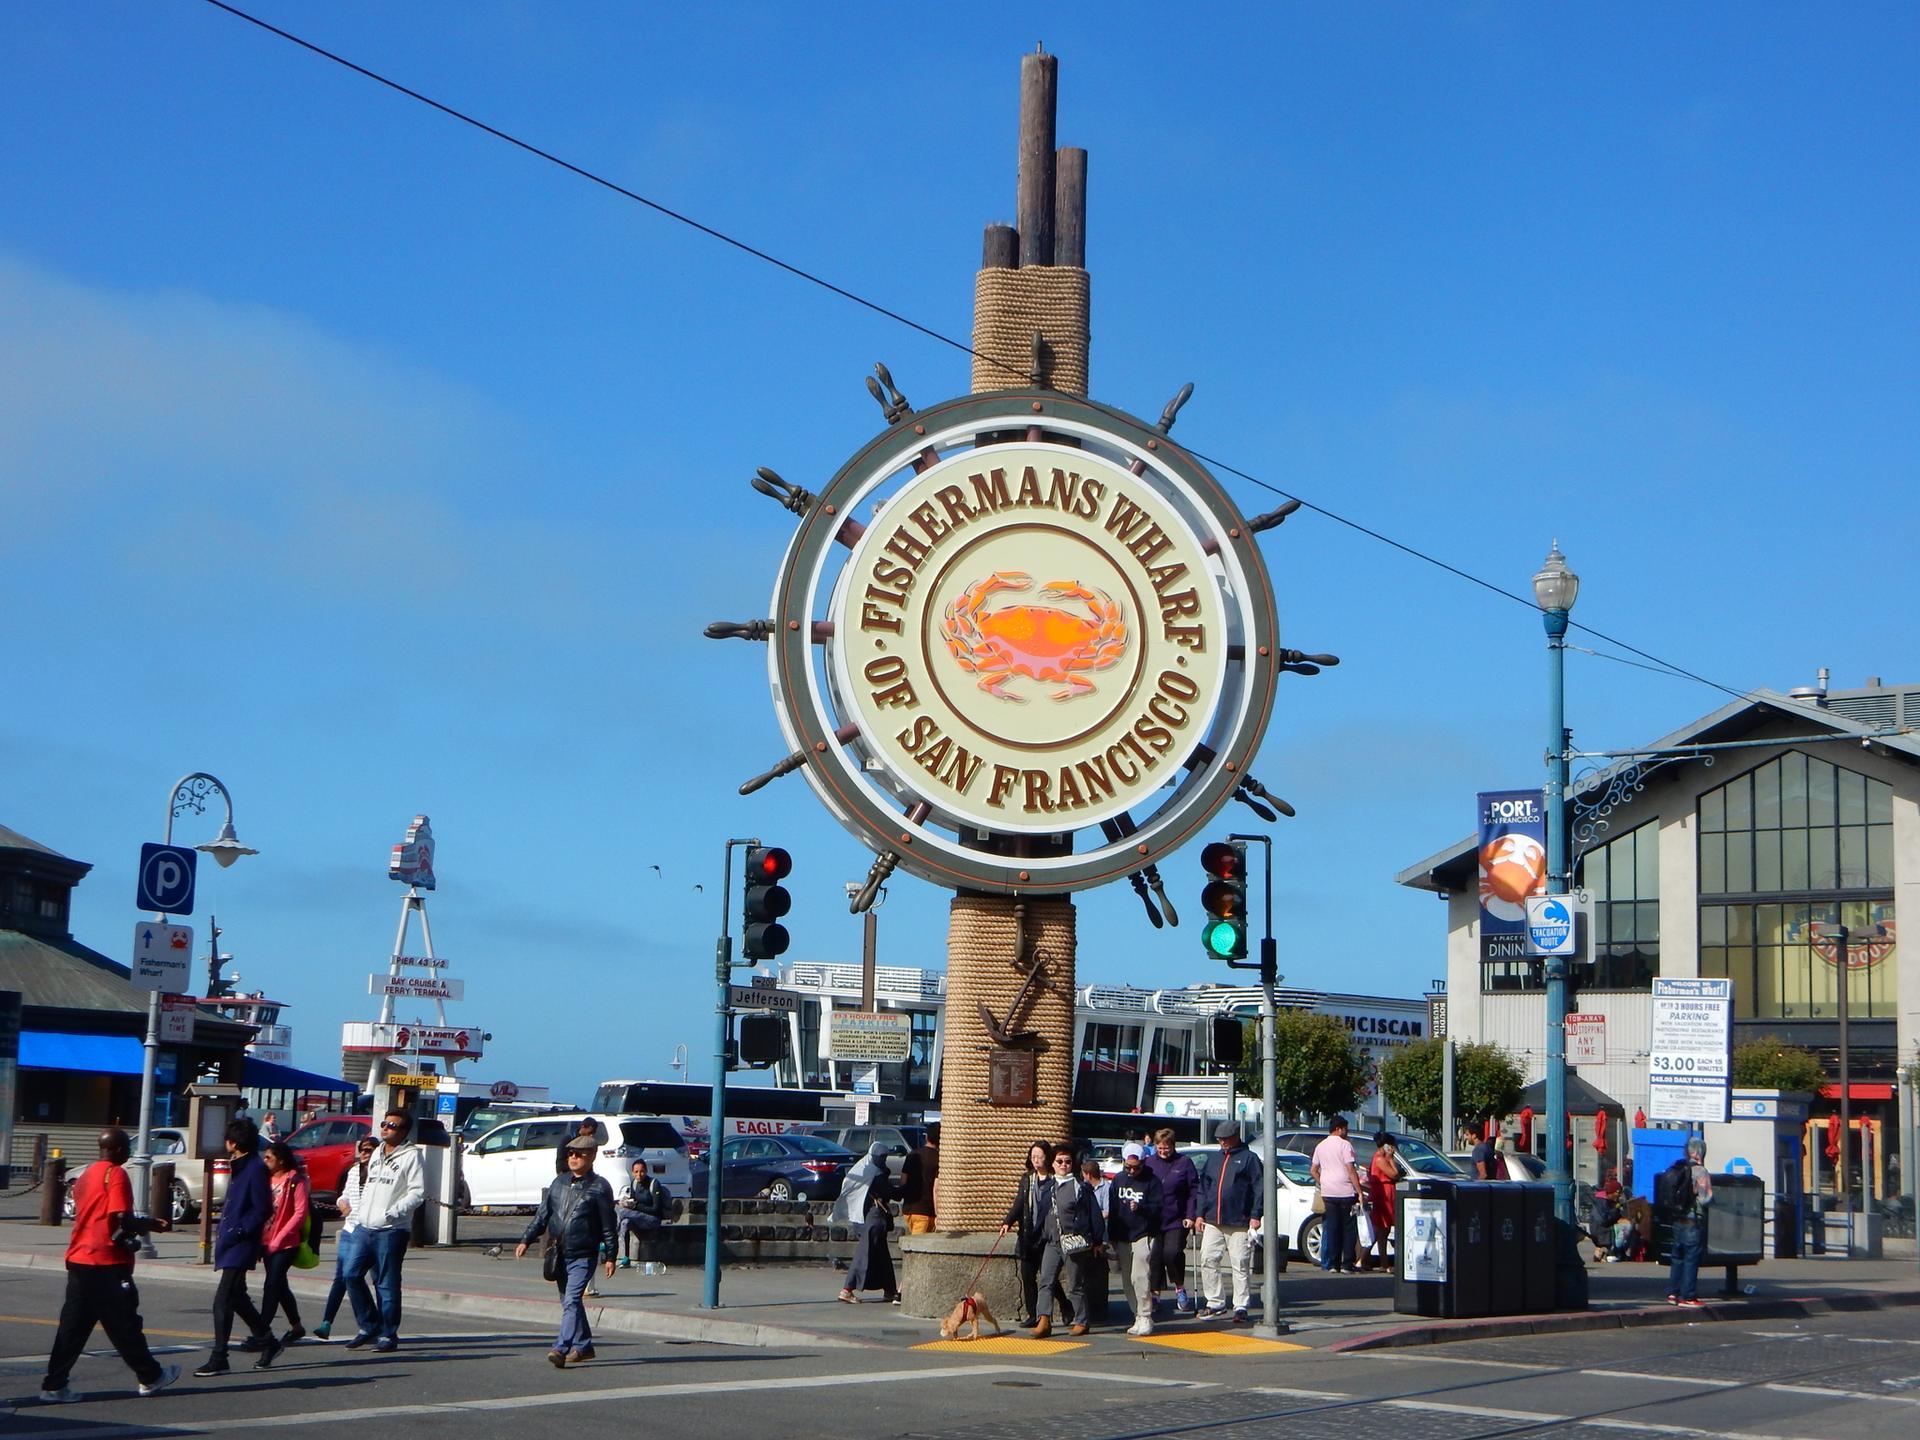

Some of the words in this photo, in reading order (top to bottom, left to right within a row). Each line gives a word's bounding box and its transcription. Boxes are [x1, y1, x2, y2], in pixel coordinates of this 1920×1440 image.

[861, 466, 1106, 635] FISHERMANS
[1104, 492, 1207, 653] WHARF
[863, 654, 919, 711] OF
[896, 714, 985, 795] SAN
[986, 669, 1202, 812] FRANCISCO
[1491, 800, 1532, 818] PORT
[1484, 817, 1498, 825] SAN
[1499, 815, 1540, 824] FRANCISCO
[1532, 927, 1567, 937] EVACUATION
[1540, 937, 1559, 947] ROUTE
[1489, 943, 1525, 957] DININ
[140, 957, 187, 969] Fisherman's
[396, 956, 414, 966] PIER
[417, 958, 429, 967] 43
[433, 960, 446, 968] 1/2
[139, 968, 163, 978] Wharf
[391, 977, 405, 985] BAY
[408, 979, 437, 988] CRUISE
[440, 981, 446, 989] &
[385, 985, 409, 995] FERRY
[414, 987, 451, 998] TERMINAL
[736, 991, 793, 1007] Jefferson
[1674, 1003, 1680, 1011] 3
[1680, 1003, 1703, 1011] HOURS
[1705, 1003, 1721, 1011] FREE
[170, 1015, 185, 1023] ANY
[1670, 1012, 1710, 1021] PARKING
[169, 1024, 187, 1033] TIME
[841, 1019, 898, 1027] PARKING
[1343, 1015, 1422, 1037] NCISCAN
[1567, 1023, 1577, 1034] NO
[433, 1031, 455, 1039] WHITE
[1578, 1025, 1604, 1034] STOPPING
[1578, 1036, 1594, 1045] ANY
[1577, 1046, 1596, 1056] TIME
[1654, 1056, 1695, 1071] $3.00
[390, 1076, 407, 1085] PAY
[410, 1078, 435, 1087] HERE
[736, 1120, 785, 1135] EAGLE
